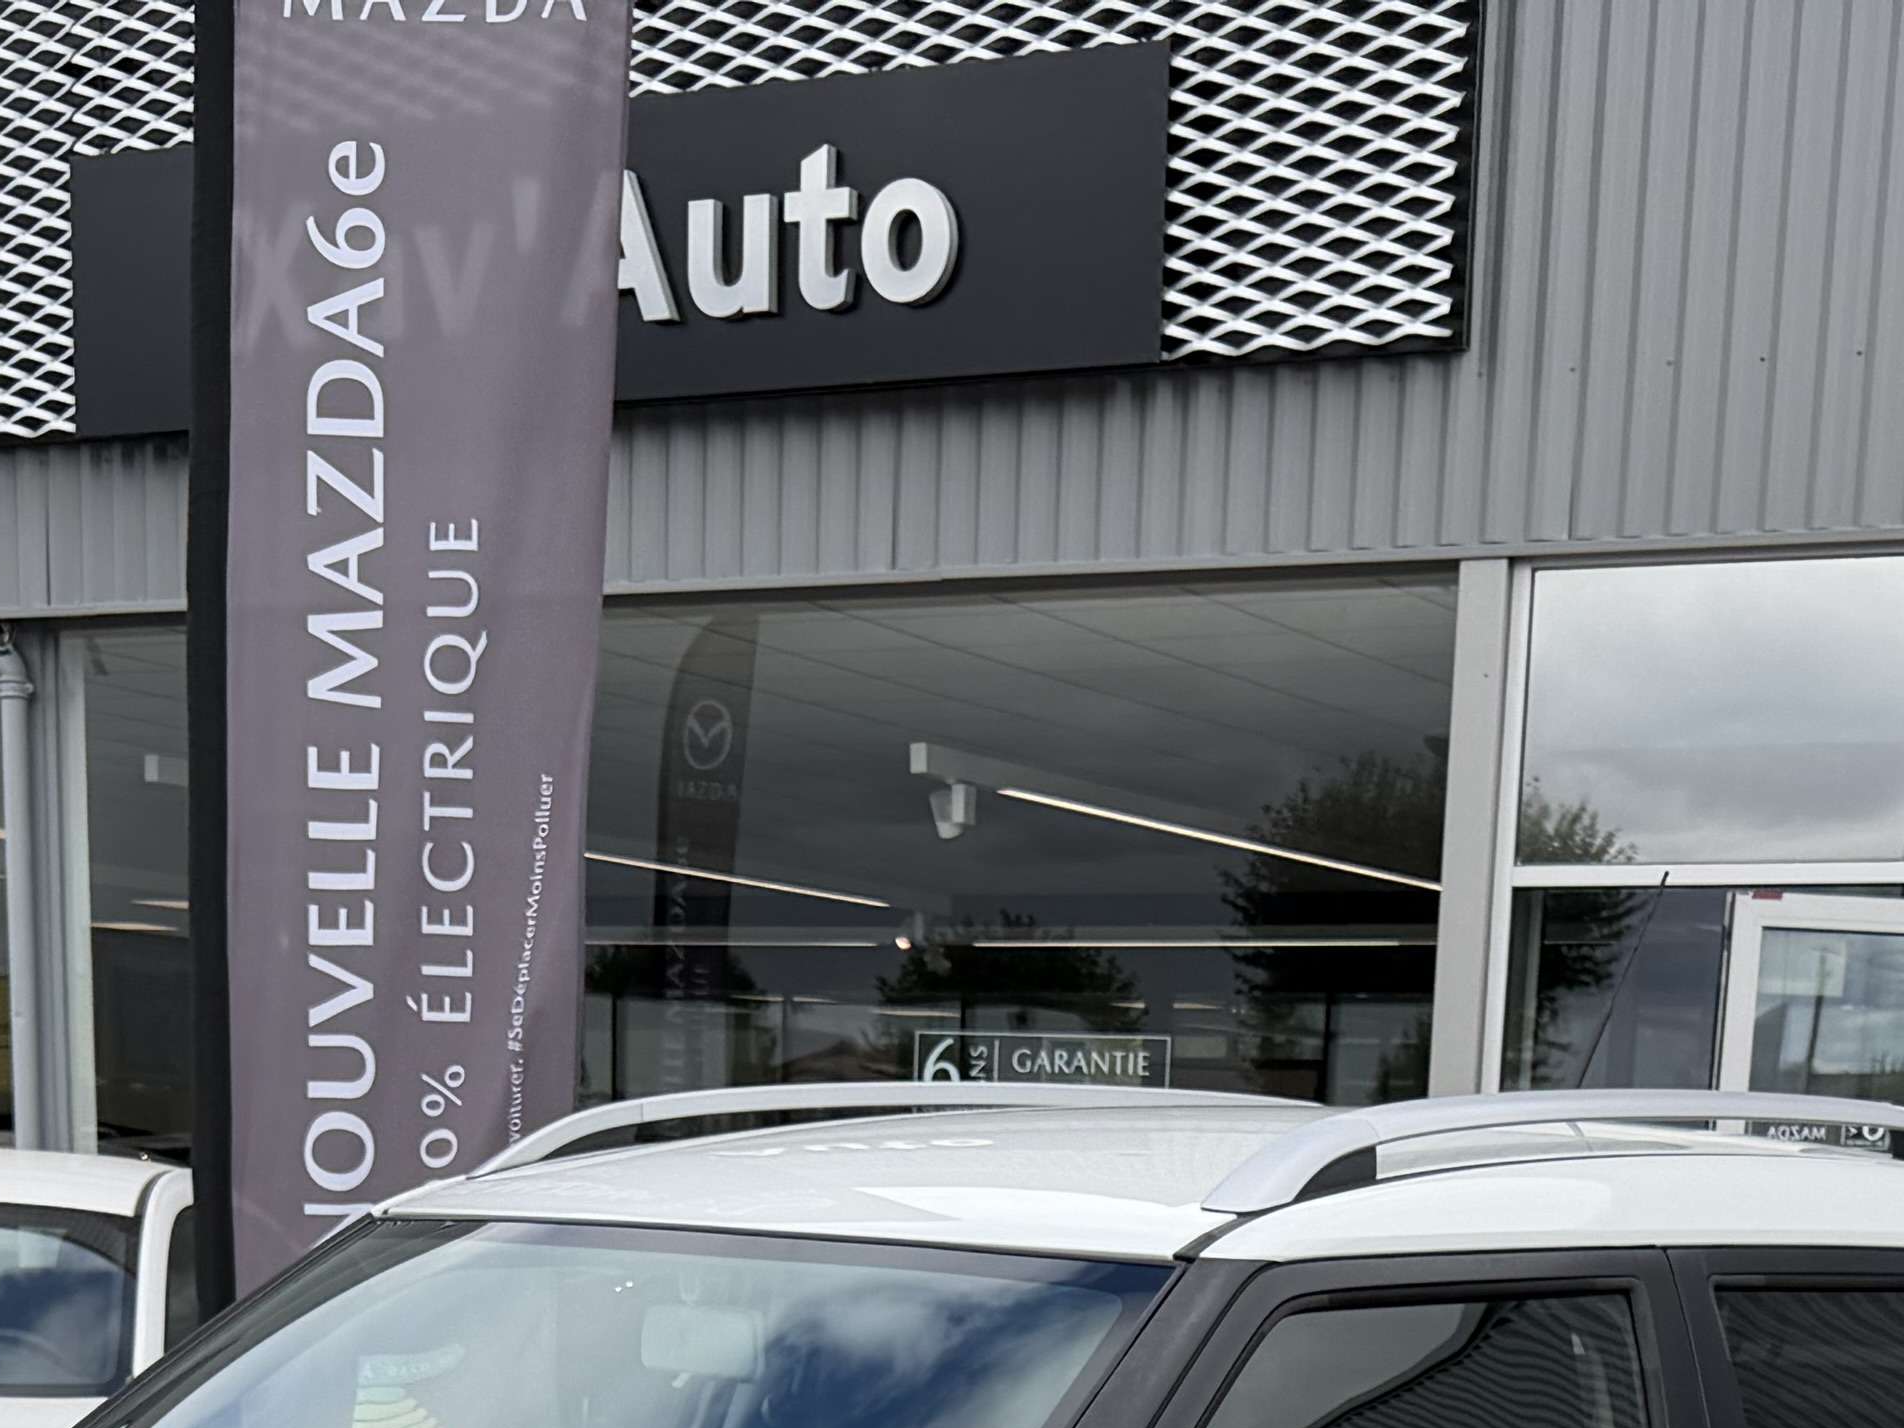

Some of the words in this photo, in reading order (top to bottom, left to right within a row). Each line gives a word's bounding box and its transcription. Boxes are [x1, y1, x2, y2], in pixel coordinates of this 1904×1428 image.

[304, 140, 386, 710] MAZDA6e
[406, 519, 488, 1024] ÉLECTRIQUE
[1011, 1049, 1152, 1077] GARANTIE
